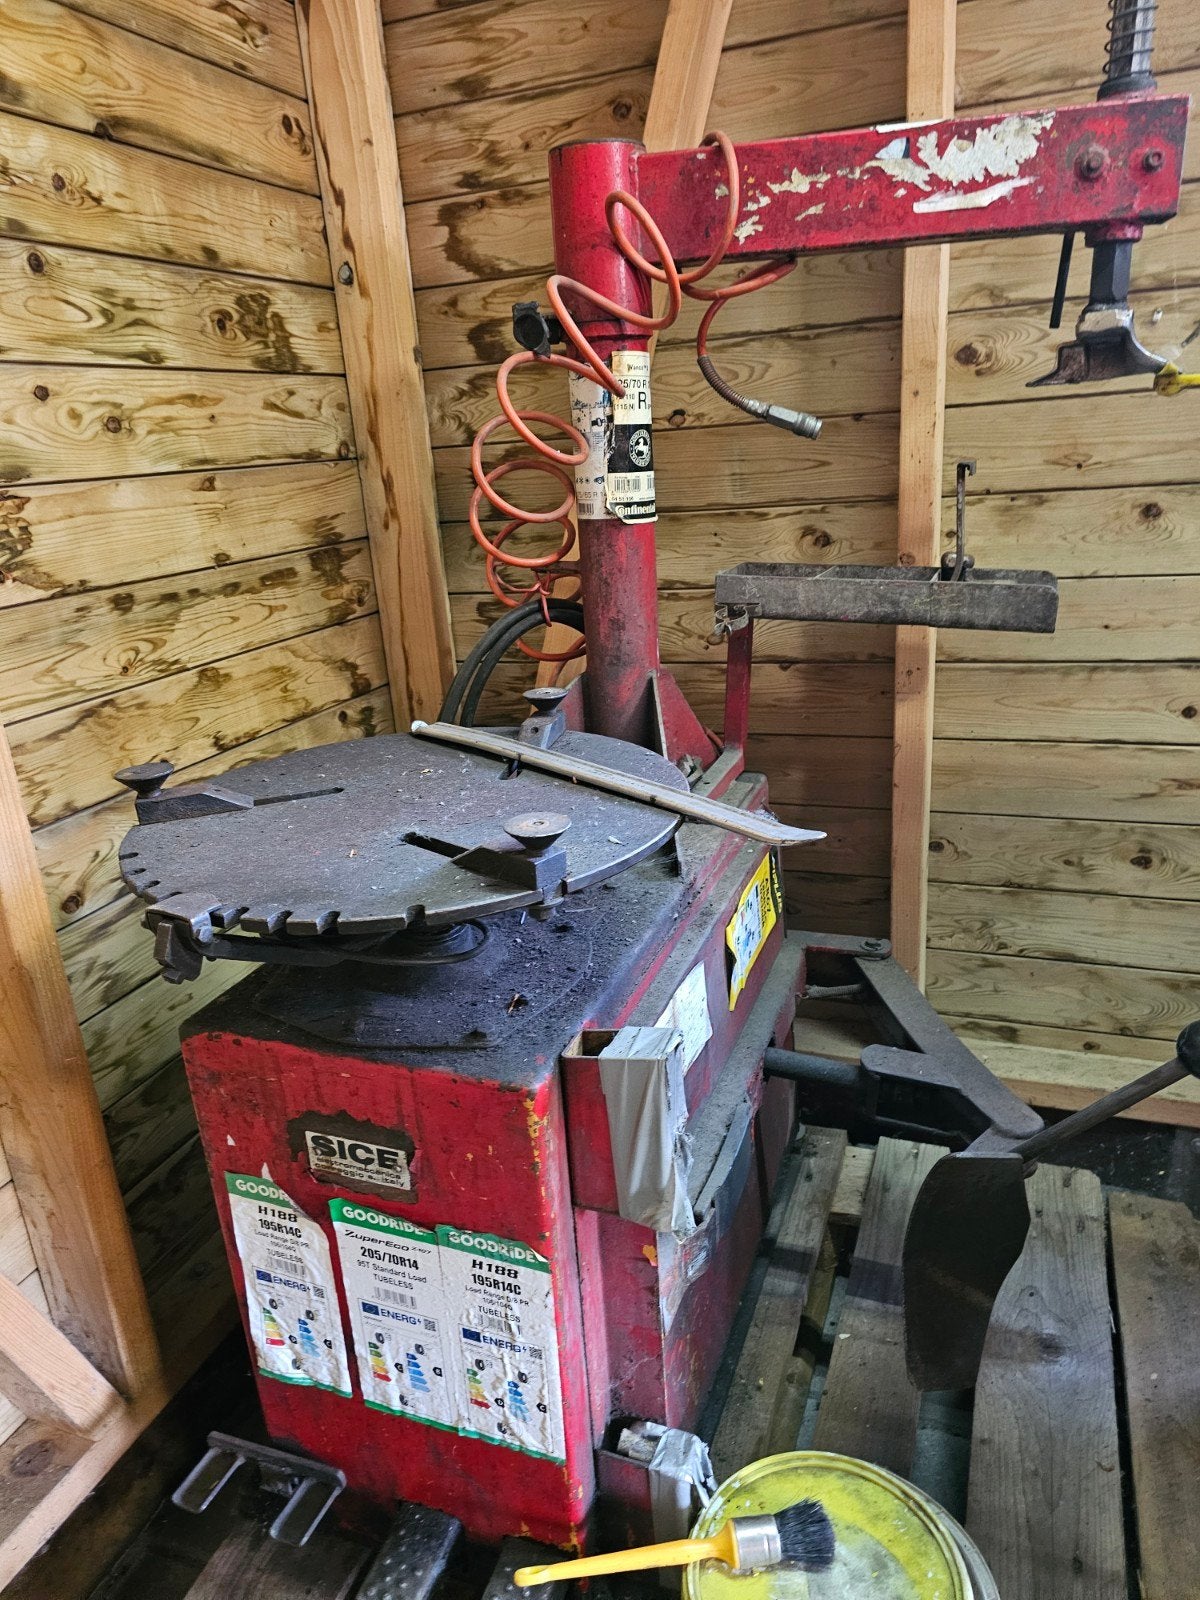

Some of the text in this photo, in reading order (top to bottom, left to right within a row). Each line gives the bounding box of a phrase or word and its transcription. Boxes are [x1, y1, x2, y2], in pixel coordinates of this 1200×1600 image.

[638, 391, 647, 410] R
[311, 1135, 399, 1169] SICE
[258, 1205, 298, 1223] H188
[258, 1218, 302, 1239] 195R14C
[266, 1247, 304, 1264] TUBELESS
[448, 1231, 536, 1263] GOODRIDE
[360, 1246, 419, 1271] 205/70R14
[372, 1263, 406, 1278] Standard
[408, 1272, 427, 1284] Load
[471, 1259, 519, 1280] H188
[373, 1273, 414, 1290] TUBELESS
[471, 1273, 522, 1296] 195R14C
[465, 1285, 482, 1294] Load
[483, 1289, 505, 1301] Range
[478, 1305, 521, 1323] TUBELESS
